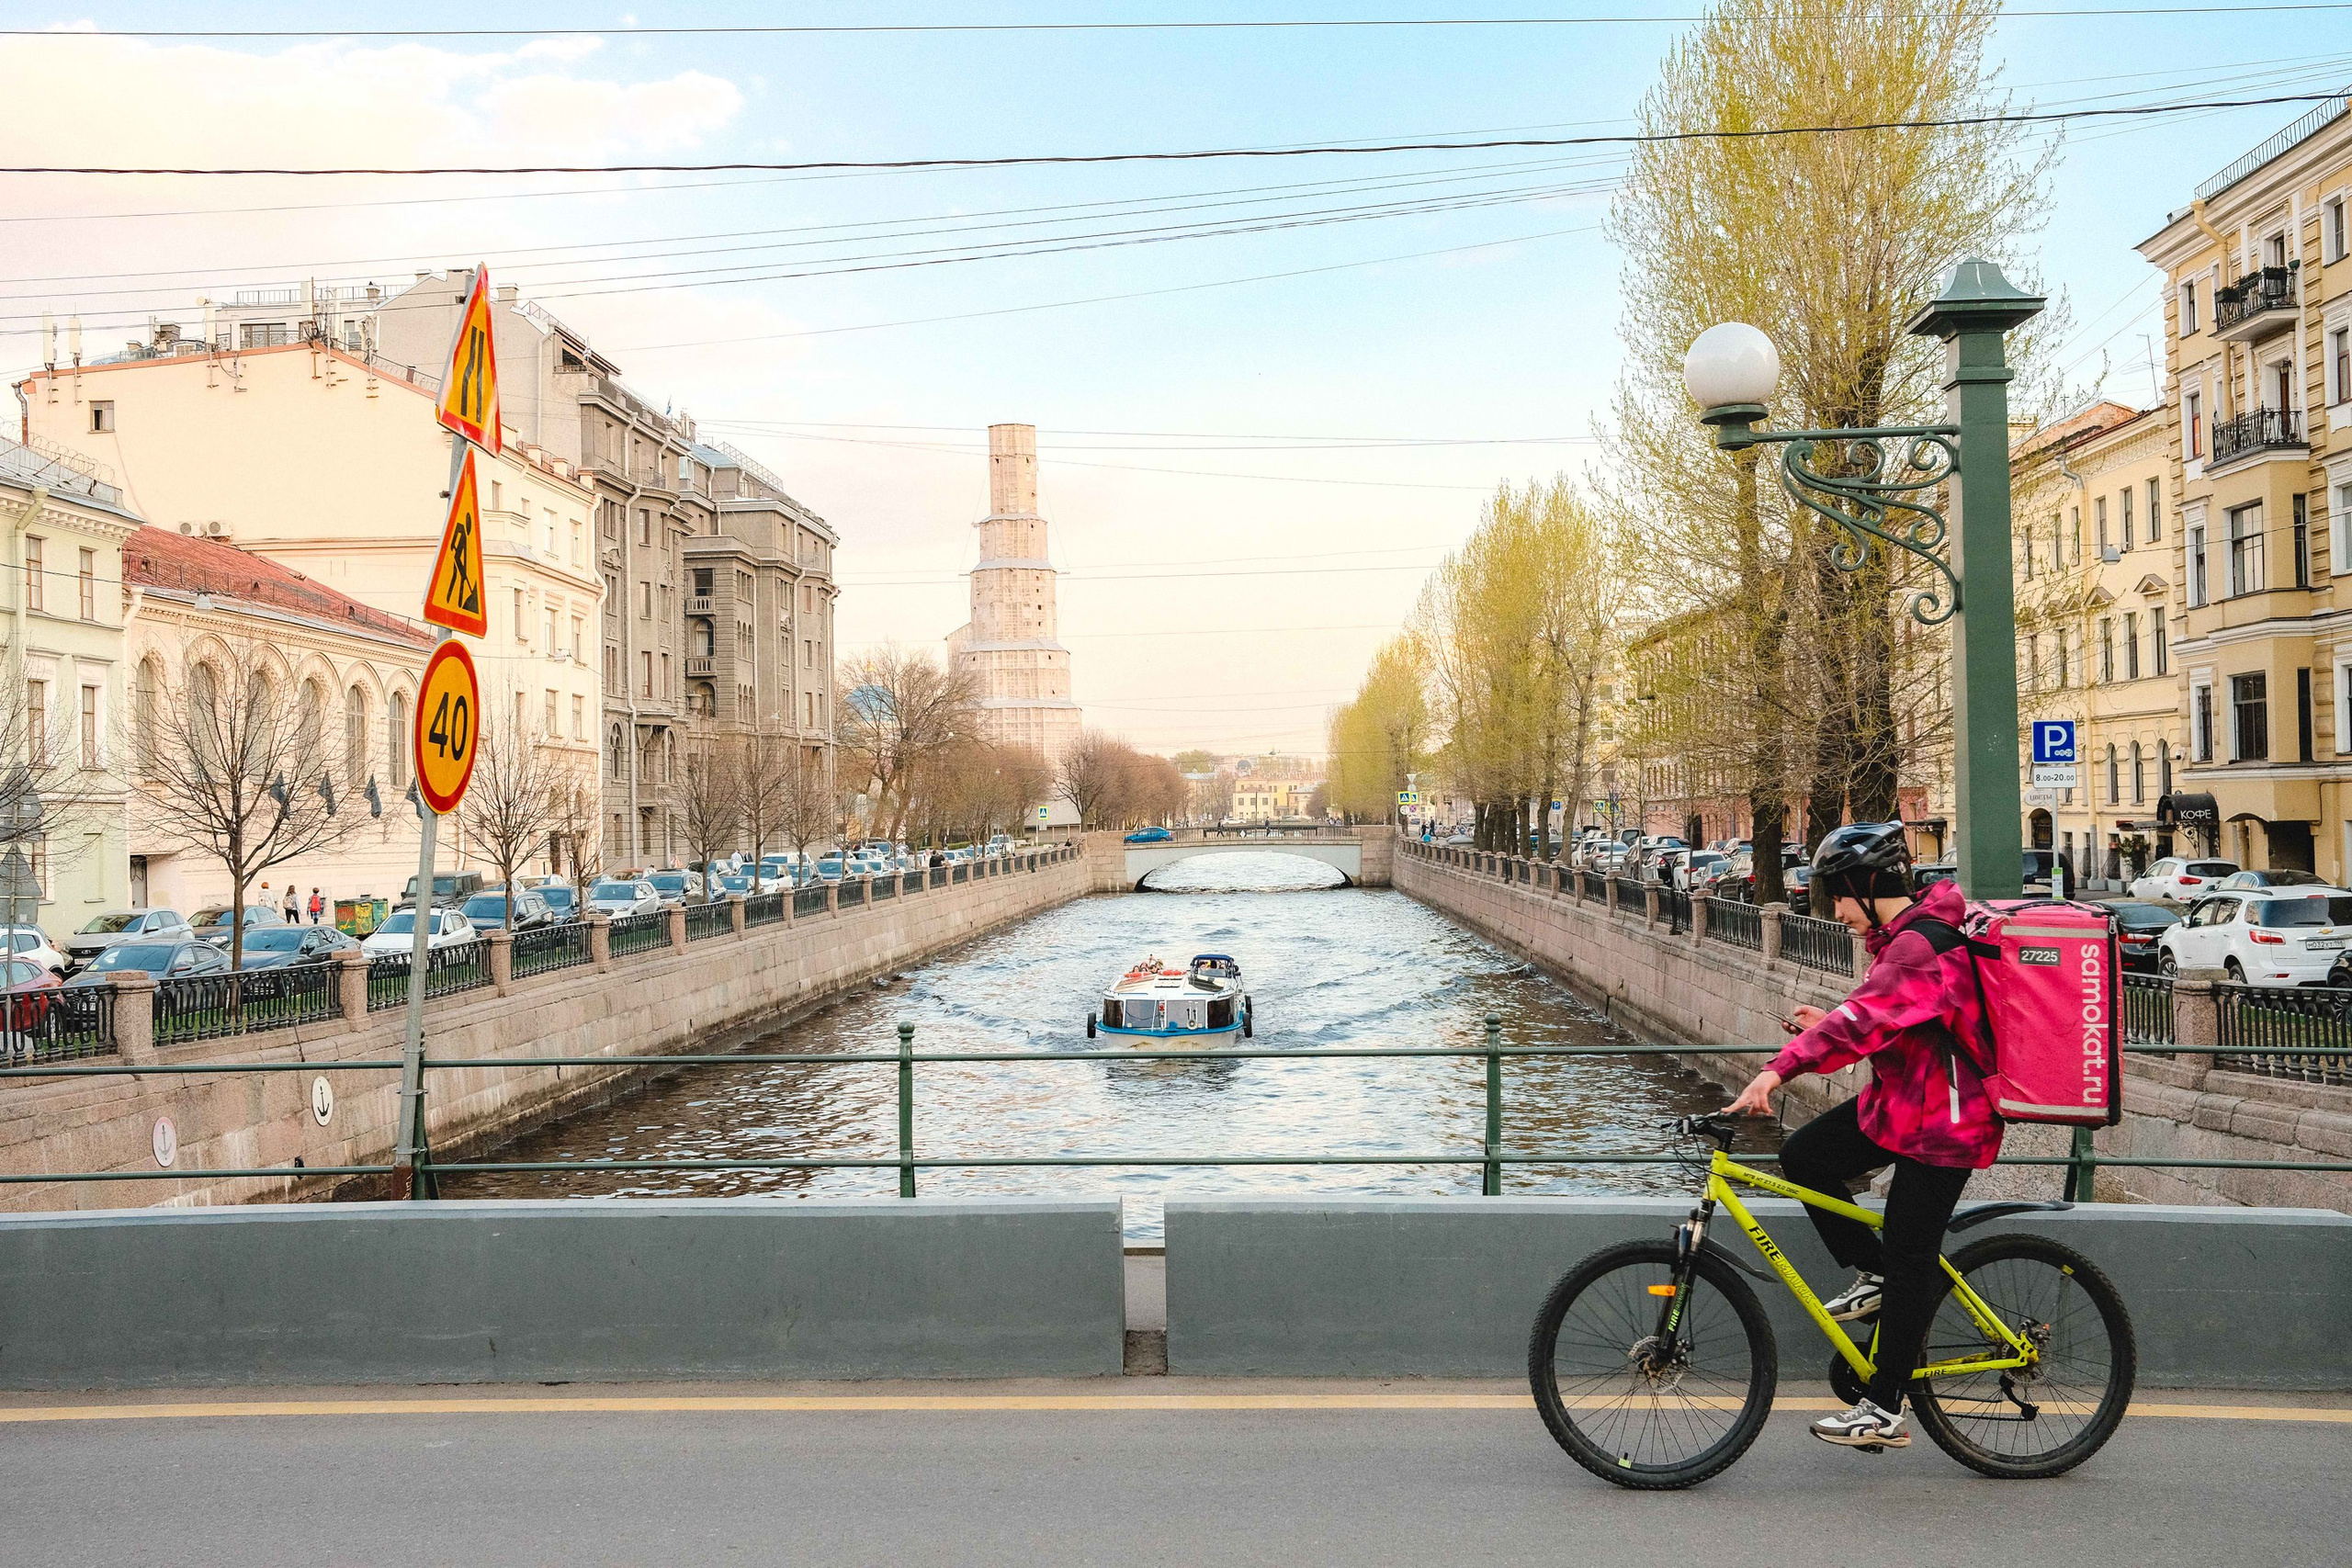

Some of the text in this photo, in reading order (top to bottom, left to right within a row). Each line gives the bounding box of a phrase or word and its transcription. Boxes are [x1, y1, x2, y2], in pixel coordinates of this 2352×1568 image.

[428, 692, 468, 761] 40
[2044, 726, 2067, 758] P
[2035, 773, 2075, 782] 8.00-20.00
[2179, 809, 2211, 819] КОФЕ
[2021, 950, 2058, 962] 27225
[2080, 943, 2109, 1103] samokat.ru
